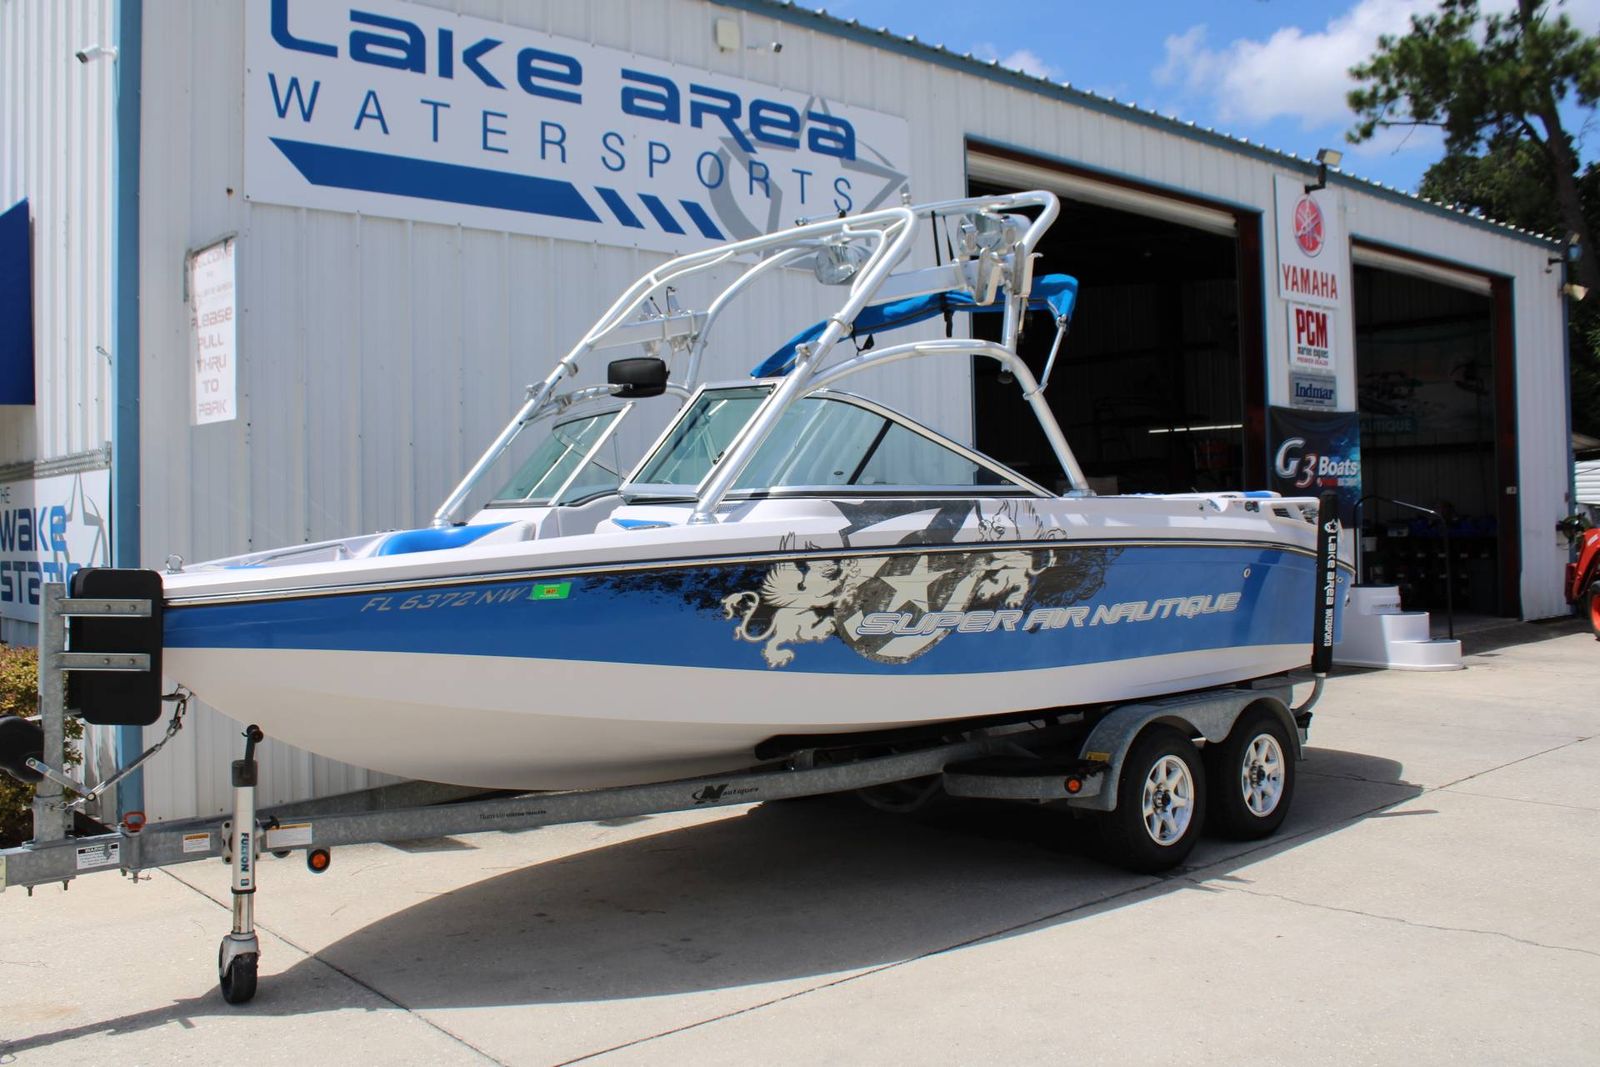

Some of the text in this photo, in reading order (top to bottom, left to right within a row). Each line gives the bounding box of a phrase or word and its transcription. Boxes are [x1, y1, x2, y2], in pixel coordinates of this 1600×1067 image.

[271, 0, 582, 105] Lake
[268, 72, 852, 212] WATERSPORTS
[1282, 264, 1338, 299] YAMAHA
[1295, 308, 1328, 348] PCM
[203, 379, 219, 393] TO
[1295, 382, 1334, 400] Indmar
[1275, 437, 1358, 488] G3 Boats
[360, 596, 392, 612] FL
[399, 591, 476, 610] 6372
[475, 586, 529, 605] NW
[855, 591, 1242, 636] SUPER AIR NAUTIQUE
[241, 832, 250, 872] FULTON
